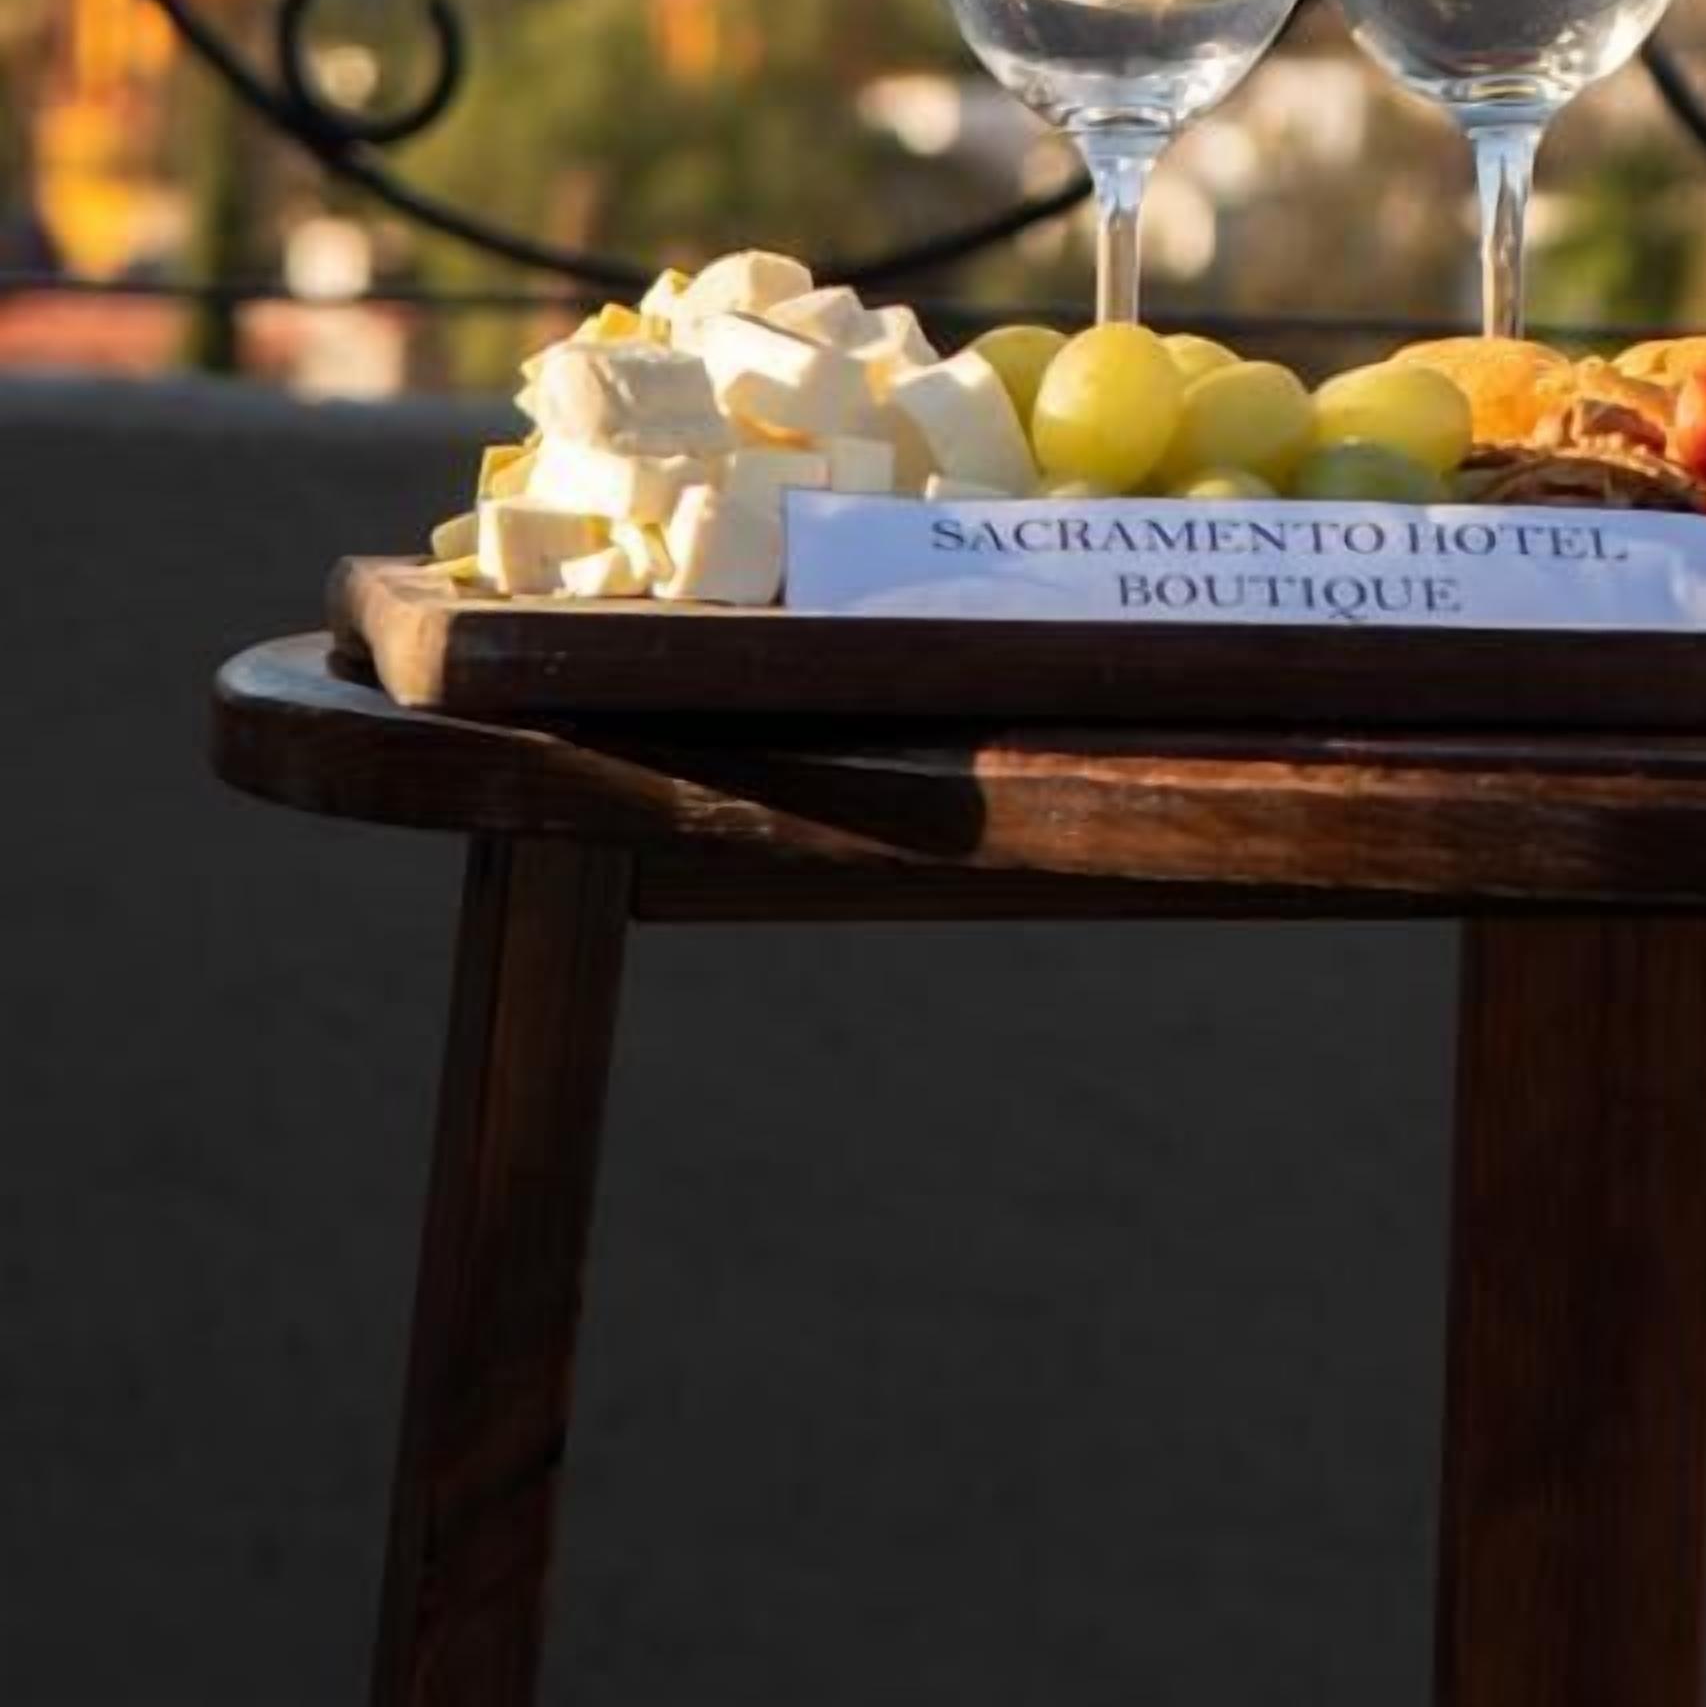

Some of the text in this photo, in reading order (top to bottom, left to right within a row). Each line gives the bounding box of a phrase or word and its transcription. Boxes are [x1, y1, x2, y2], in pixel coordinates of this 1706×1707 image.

[930, 518, 1629, 561] SACRAMENTO HOTEL
[1116, 573, 1463, 619] BOUTIQUE
